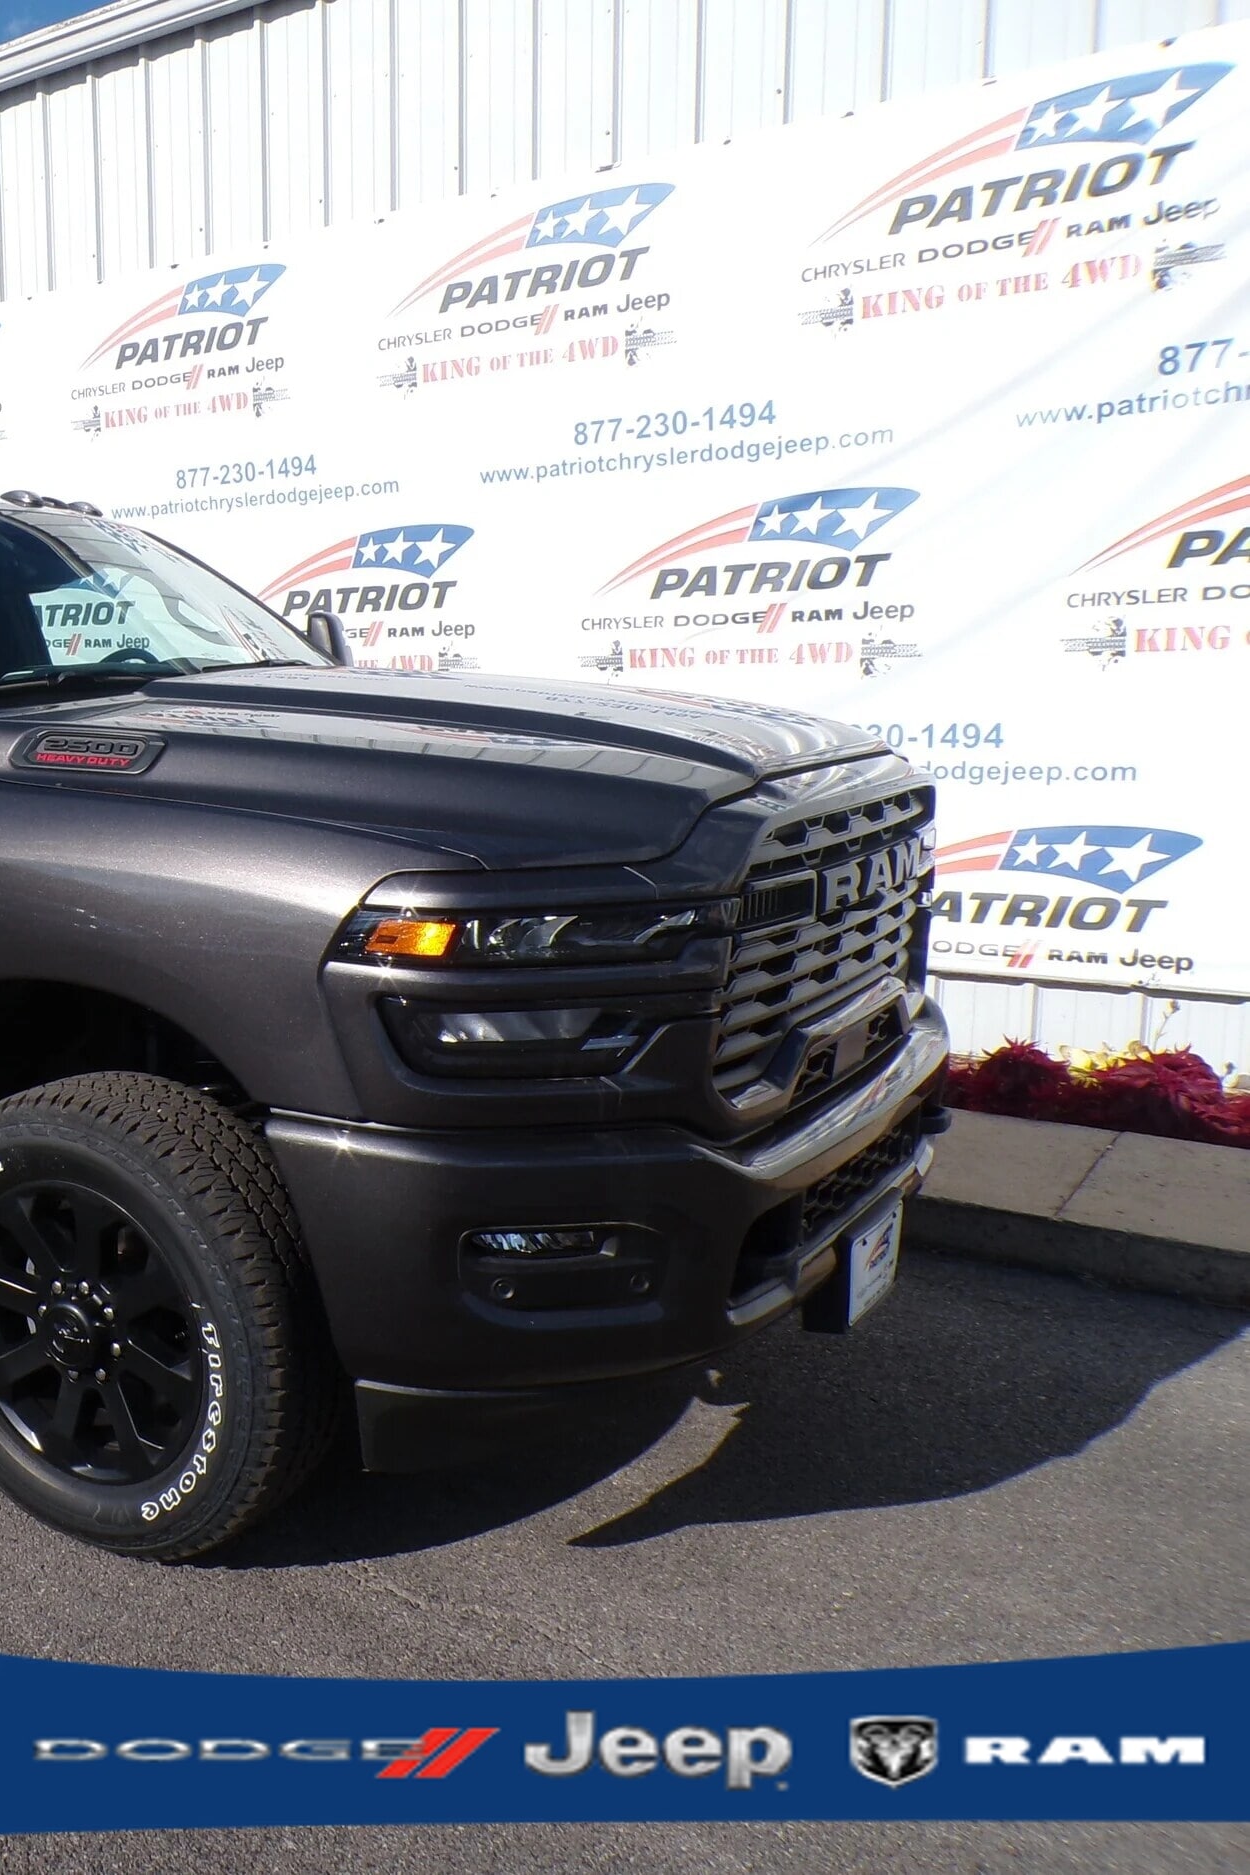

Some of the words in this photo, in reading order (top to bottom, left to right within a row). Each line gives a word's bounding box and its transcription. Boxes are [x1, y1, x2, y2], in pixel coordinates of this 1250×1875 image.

[888, 140, 1197, 236] PATRIOT
[801, 252, 906, 283] CHRYSLER
[918, 231, 1037, 263] DODGE
[1066, 213, 1132, 239] RAM
[1143, 198, 1220, 226] Jeep
[438, 246, 650, 314] PATRIOT
[861, 285, 945, 320] KING
[957, 282, 988, 302] OF
[996, 272, 1048, 297] THE
[1061, 254, 1143, 289] 4WD
[378, 328, 452, 351] CHRYSLER
[461, 313, 544, 338] DODGE
[564, 303, 608, 322] RAM
[616, 292, 671, 313] Jeep
[115, 316, 269, 370] PATRIOT
[422, 356, 481, 384] KING
[489, 354, 512, 371] OF
[516, 348, 554, 368] THE
[562, 335, 619, 363] 4WD
[71, 382, 126, 401] CHRYSLER
[131, 371, 192, 391] DODGE
[207, 365, 240, 379] RAM
[245, 356, 285, 373] Jeep
[104, 405, 148, 429] KING
[154, 405, 170, 420] OF
[174, 401, 201, 417] THE
[207, 391, 249, 414] 4WD
[573, 400, 777, 447] 877-230-1494
[176, 454, 317, 489] 877-230-1494
[480, 426, 894, 485] www.patriotchryslerdodgejeep.com
[111, 479, 399, 520] www.patriotchryslerdodgejeep.com
[650, 553, 893, 600] PATRIOT
[282, 580, 458, 617] PATRIOT
[581, 615, 665, 631] CHRYSLER
[673, 611, 768, 627] DODGE
[791, 608, 843, 623] RAM
[852, 601, 915, 622] Jeep
[1066, 587, 1188, 608] CHRYSLER
[84, 638, 112, 649] RAM
[116, 633, 150, 650] Jeep
[387, 626, 425, 638] RAM
[432, 621, 476, 639] Jeep
[1134, 625, 1230, 653] KING
[629, 647, 696, 669] KING
[705, 648, 731, 665] OF
[736, 647, 779, 664] THE
[789, 642, 853, 666] 4WD
[44, 738, 139, 756] 2500
[851, 722, 1005, 749] 30-1494
[35, 752, 85, 765] HEAVY
[86, 756, 131, 767] DUTY
[822, 838, 921, 916] RAM
[1048, 949, 1108, 965] RAM
[1119, 948, 1194, 975] Jeep
[141, 1322, 224, 1521] Firestone
